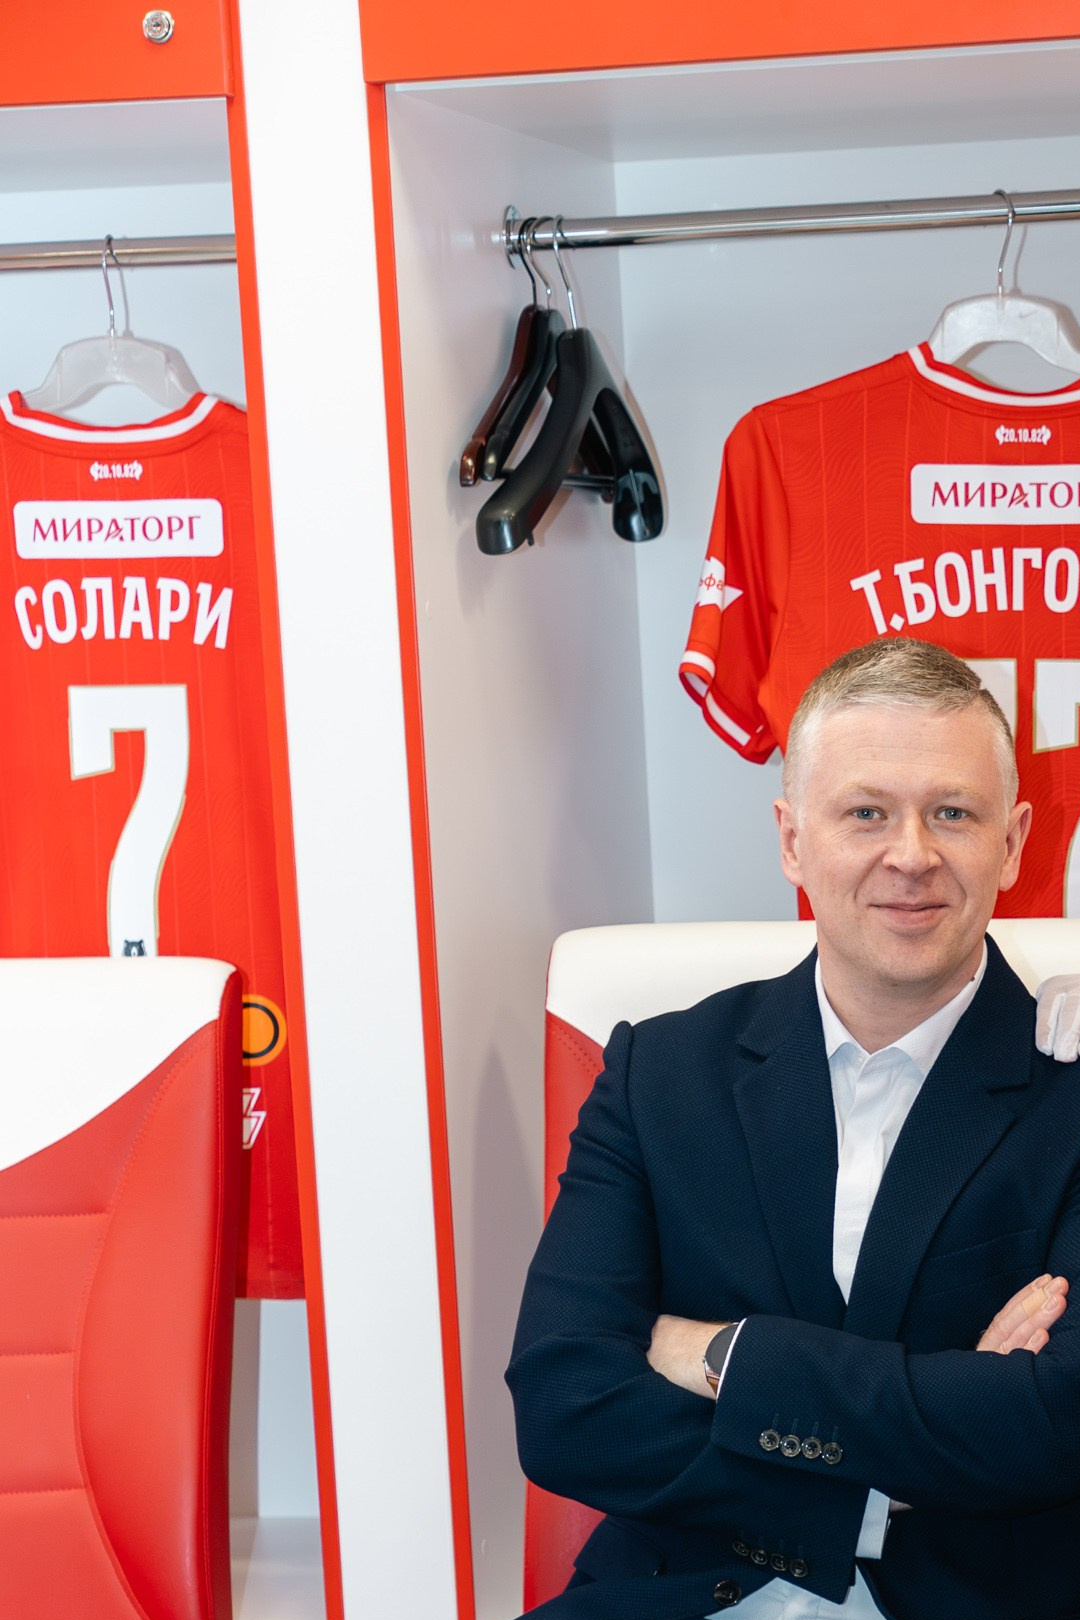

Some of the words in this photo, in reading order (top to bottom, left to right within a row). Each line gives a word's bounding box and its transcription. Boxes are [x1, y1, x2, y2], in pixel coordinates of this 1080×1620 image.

[1003, 427, 1044, 443] 20.10.82
[33, 516, 201, 542] МИРАТОРГ
[14, 576, 234, 650] СОЛАРИ
[68, 684, 190, 957] 7
